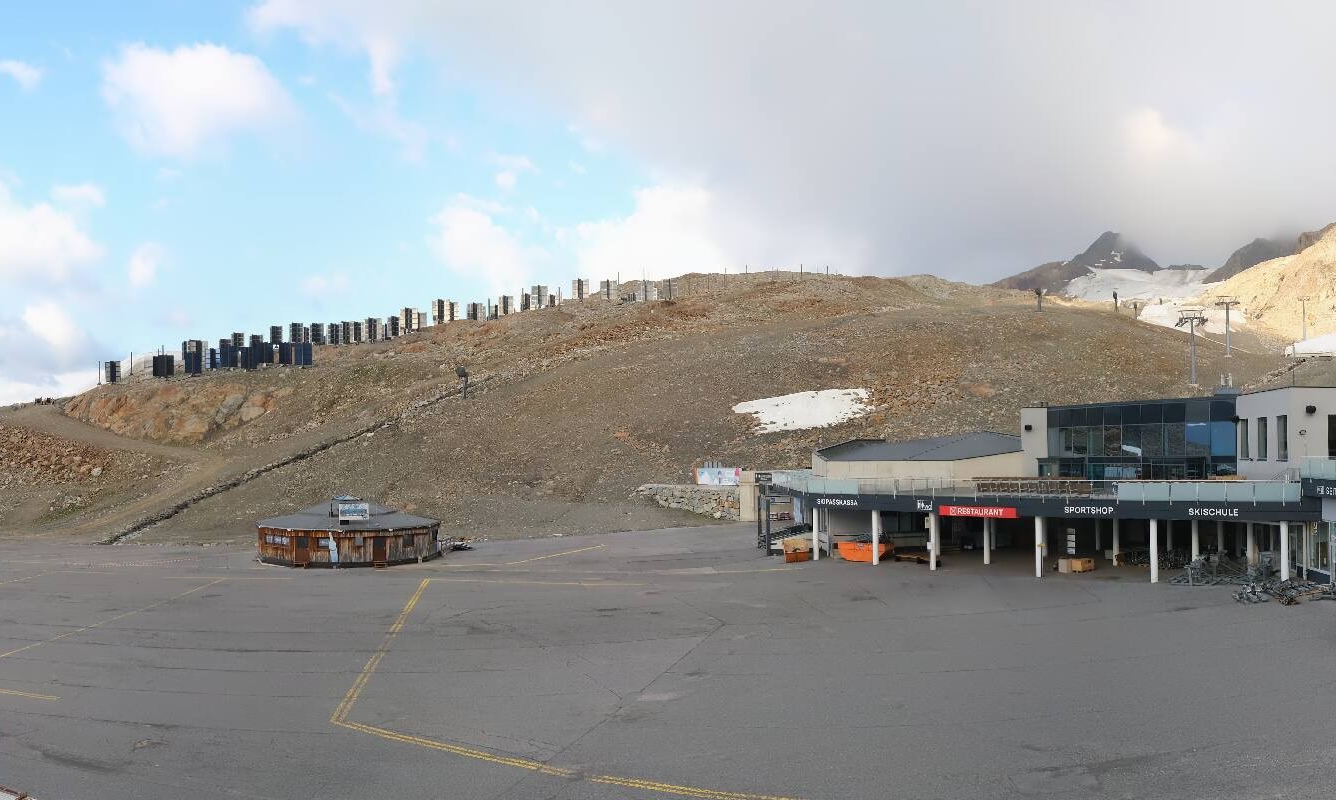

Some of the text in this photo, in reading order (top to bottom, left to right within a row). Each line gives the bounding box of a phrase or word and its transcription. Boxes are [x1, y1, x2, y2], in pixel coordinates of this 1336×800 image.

[957, 507, 1004, 516] RESTAURANT
[1064, 506, 1114, 515] SPORTSHOP
[1188, 508, 1239, 517] SKISCHULE
